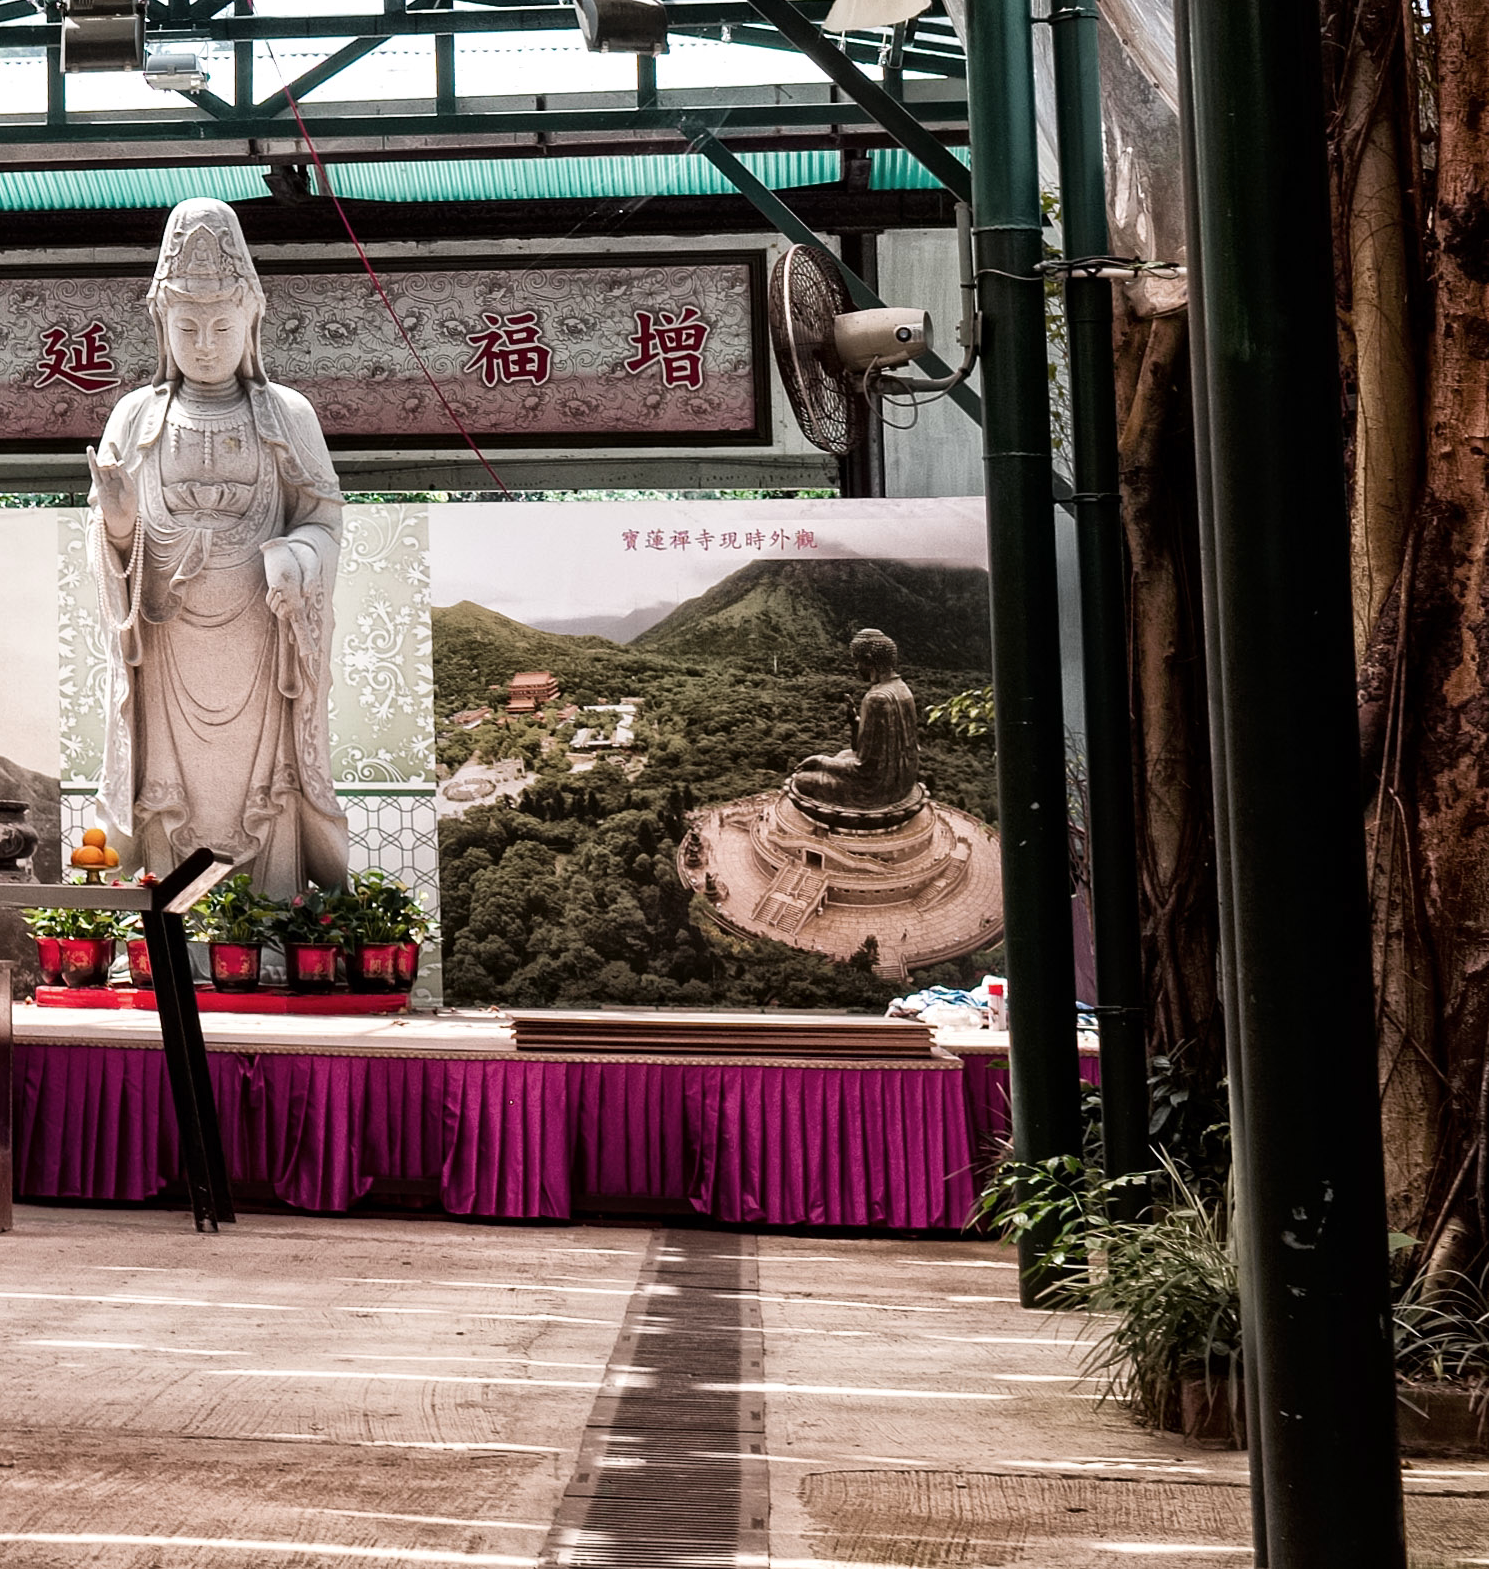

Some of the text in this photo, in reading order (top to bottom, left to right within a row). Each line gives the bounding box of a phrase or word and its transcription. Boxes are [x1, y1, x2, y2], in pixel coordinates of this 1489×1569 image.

[622, 528, 818, 551] 寶蓮禪寺現時外觀
